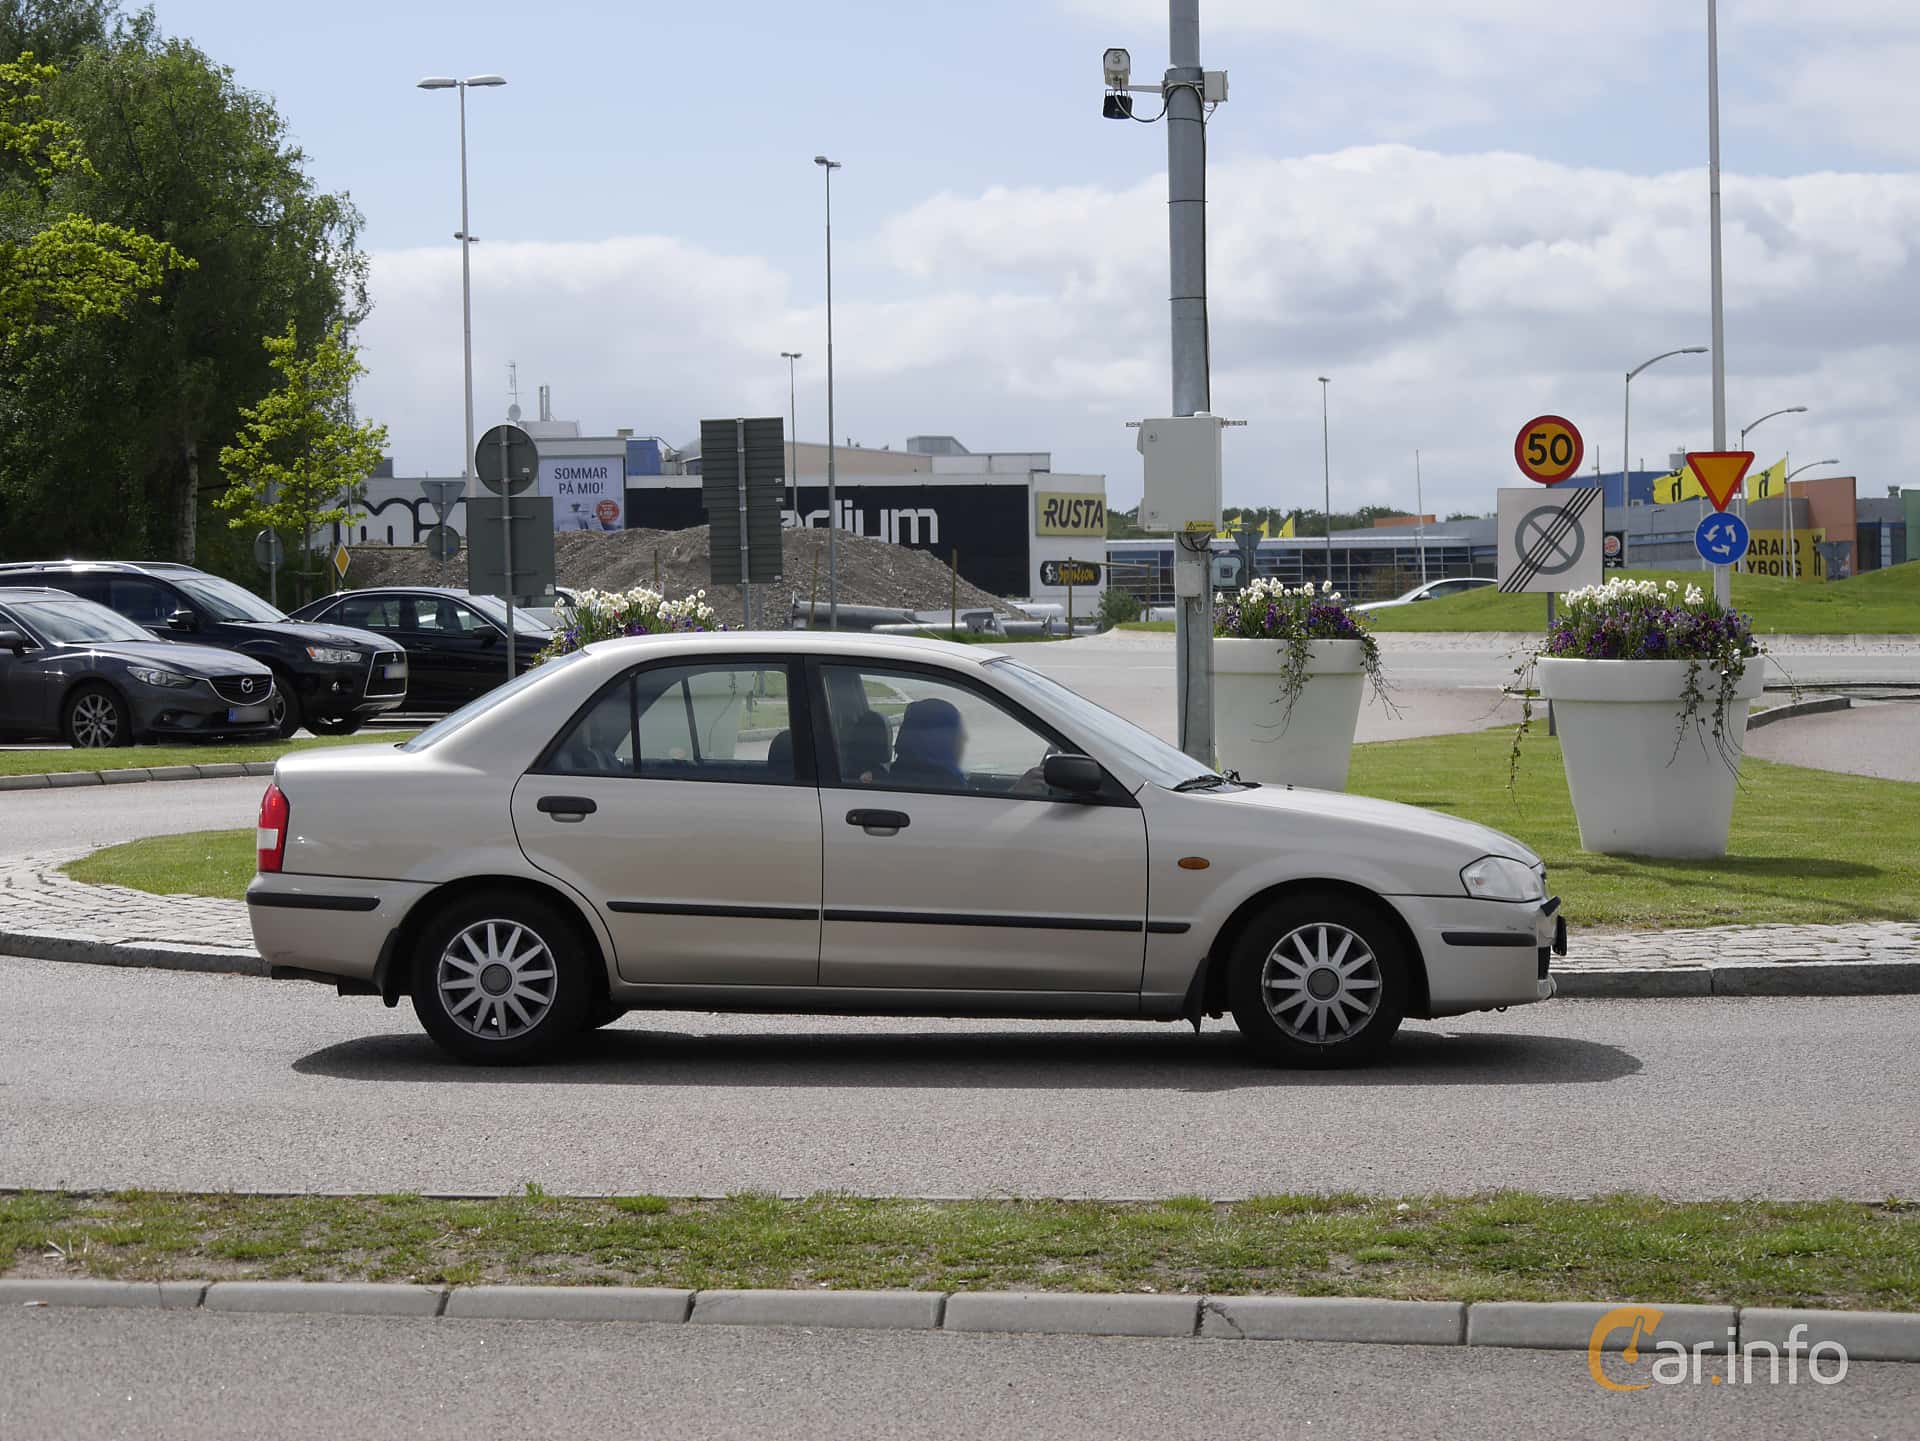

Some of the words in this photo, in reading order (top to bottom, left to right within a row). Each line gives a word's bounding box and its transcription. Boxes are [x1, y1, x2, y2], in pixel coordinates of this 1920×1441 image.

[1528, 433, 1573, 466] 50
[554, 467, 608, 480] SOMMAR
[559, 481, 574, 495] PÅ
[577, 482, 604, 495] MIO!
[780, 499, 939, 544] adium
[1043, 498, 1104, 529] RUSTA
[1747, 538, 1801, 556] ARALD
